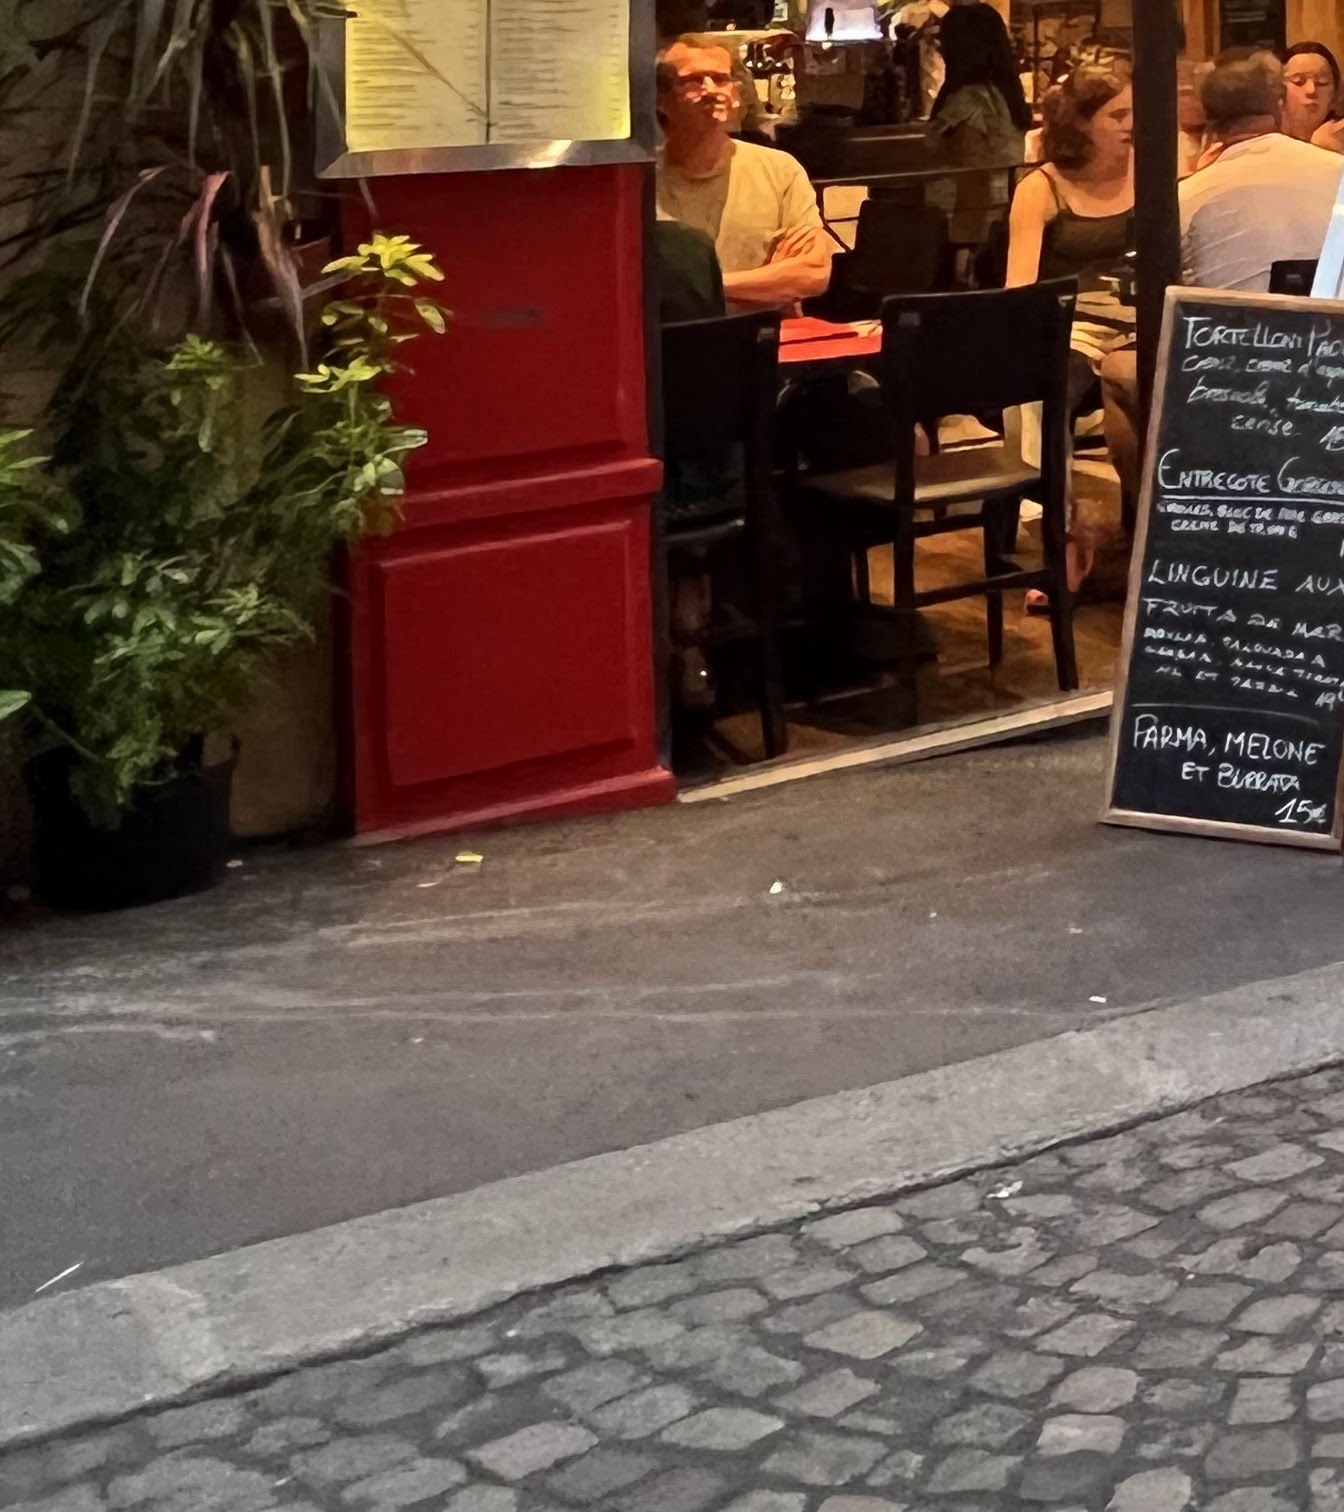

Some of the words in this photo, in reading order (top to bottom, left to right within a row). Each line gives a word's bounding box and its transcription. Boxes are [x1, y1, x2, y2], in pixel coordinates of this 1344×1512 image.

[1148, 559, 1278, 590] LINGUINE
[1133, 714, 1216, 756] PARMA,
[1224, 732, 1326, 767] MELONE
[1181, 761, 1210, 782] ET
